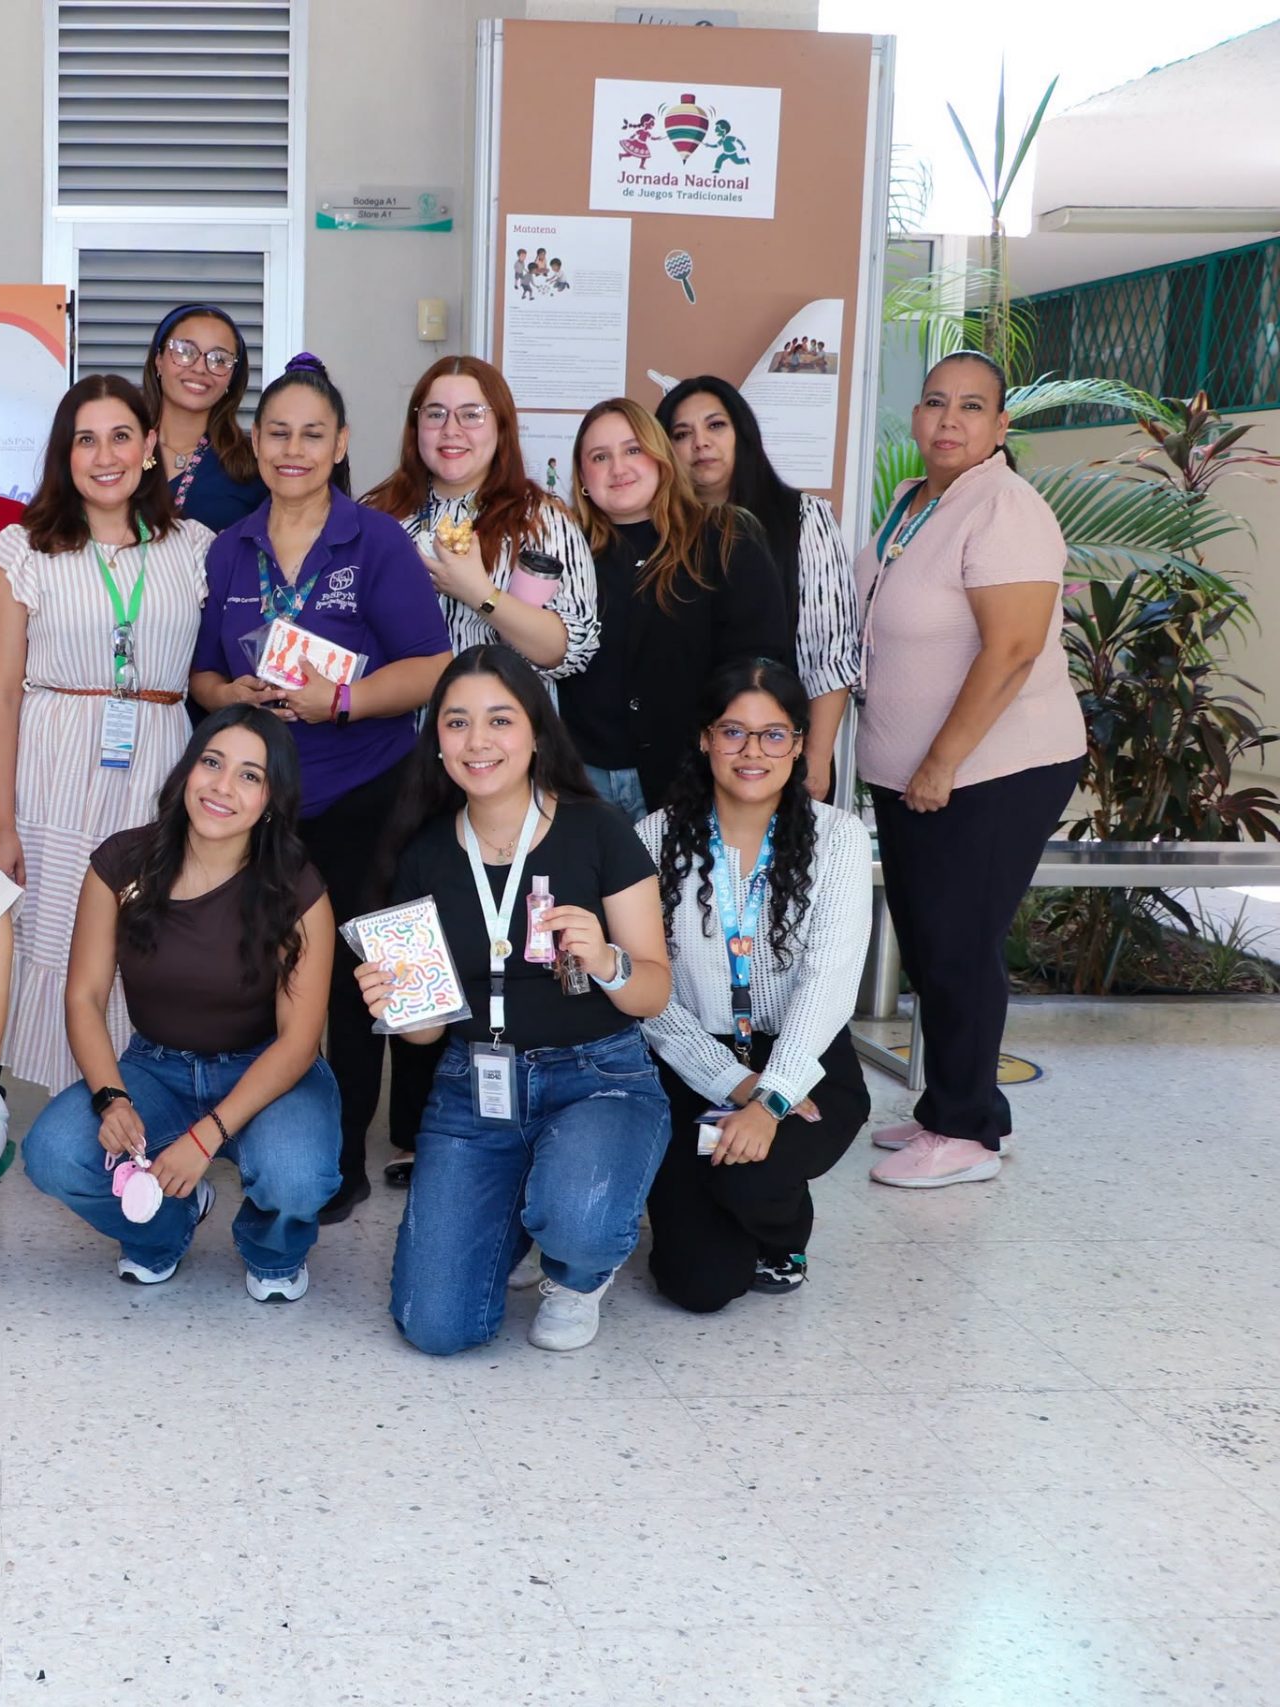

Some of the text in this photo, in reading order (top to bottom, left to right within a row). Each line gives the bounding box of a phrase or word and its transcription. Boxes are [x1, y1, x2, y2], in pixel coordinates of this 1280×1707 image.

[617, 171, 749, 190] Jornada Nacional
[622, 187, 743, 202] de Juegos Tradicionales
[353, 197, 397, 206] Bodega A1
[358, 210, 392, 218] Store A1
[513, 224, 557, 234] Matatena
